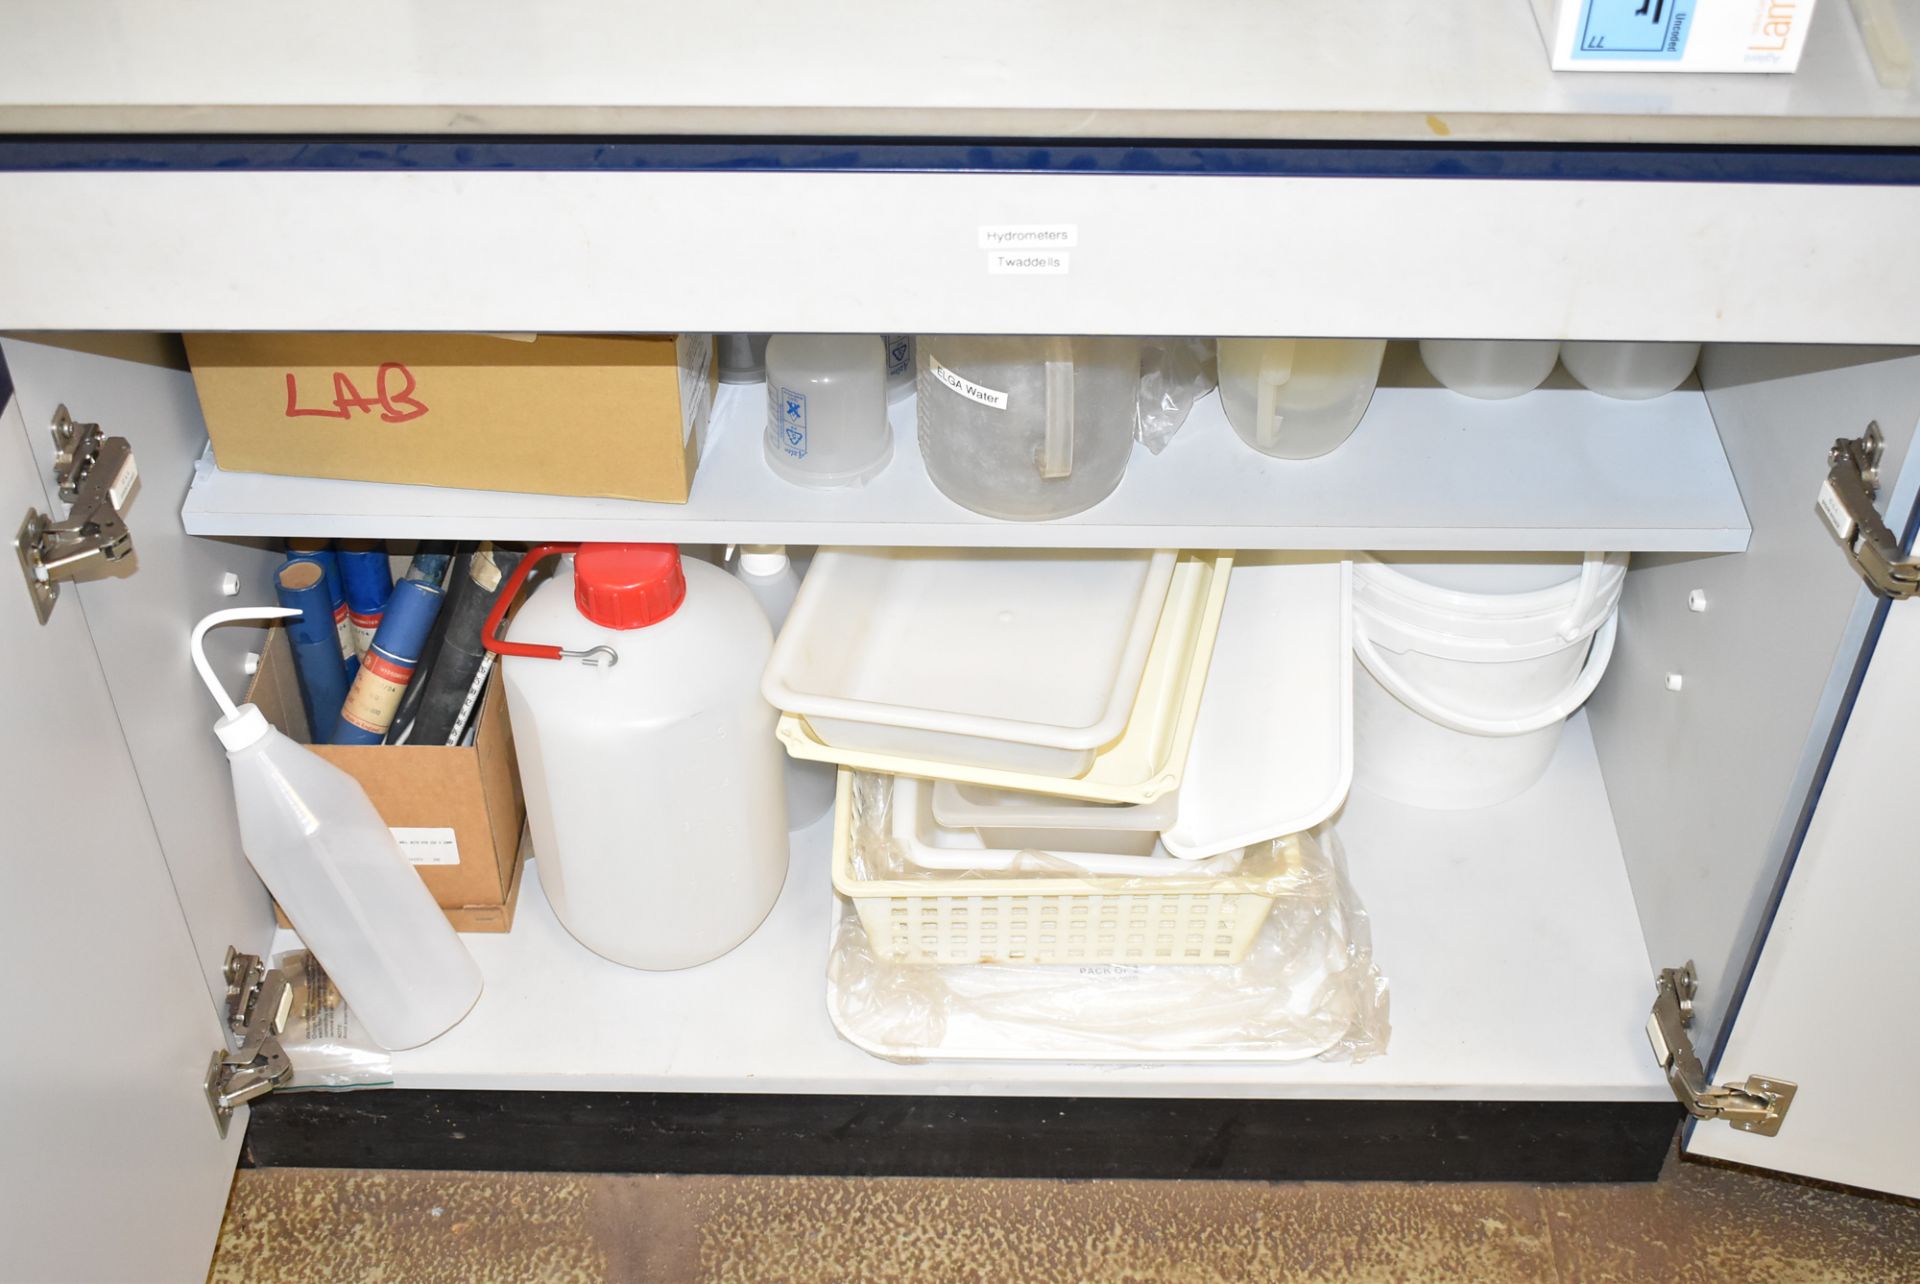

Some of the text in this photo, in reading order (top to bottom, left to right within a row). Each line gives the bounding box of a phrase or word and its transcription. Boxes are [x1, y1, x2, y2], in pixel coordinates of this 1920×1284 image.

[1667, 13, 1687, 52] Uncoded
[987, 230, 1069, 243] Hydrometers
[998, 256, 1061, 268] Twaddells
[286, 362, 429, 423] LAB
[937, 366, 1000, 403] ELGA Water
